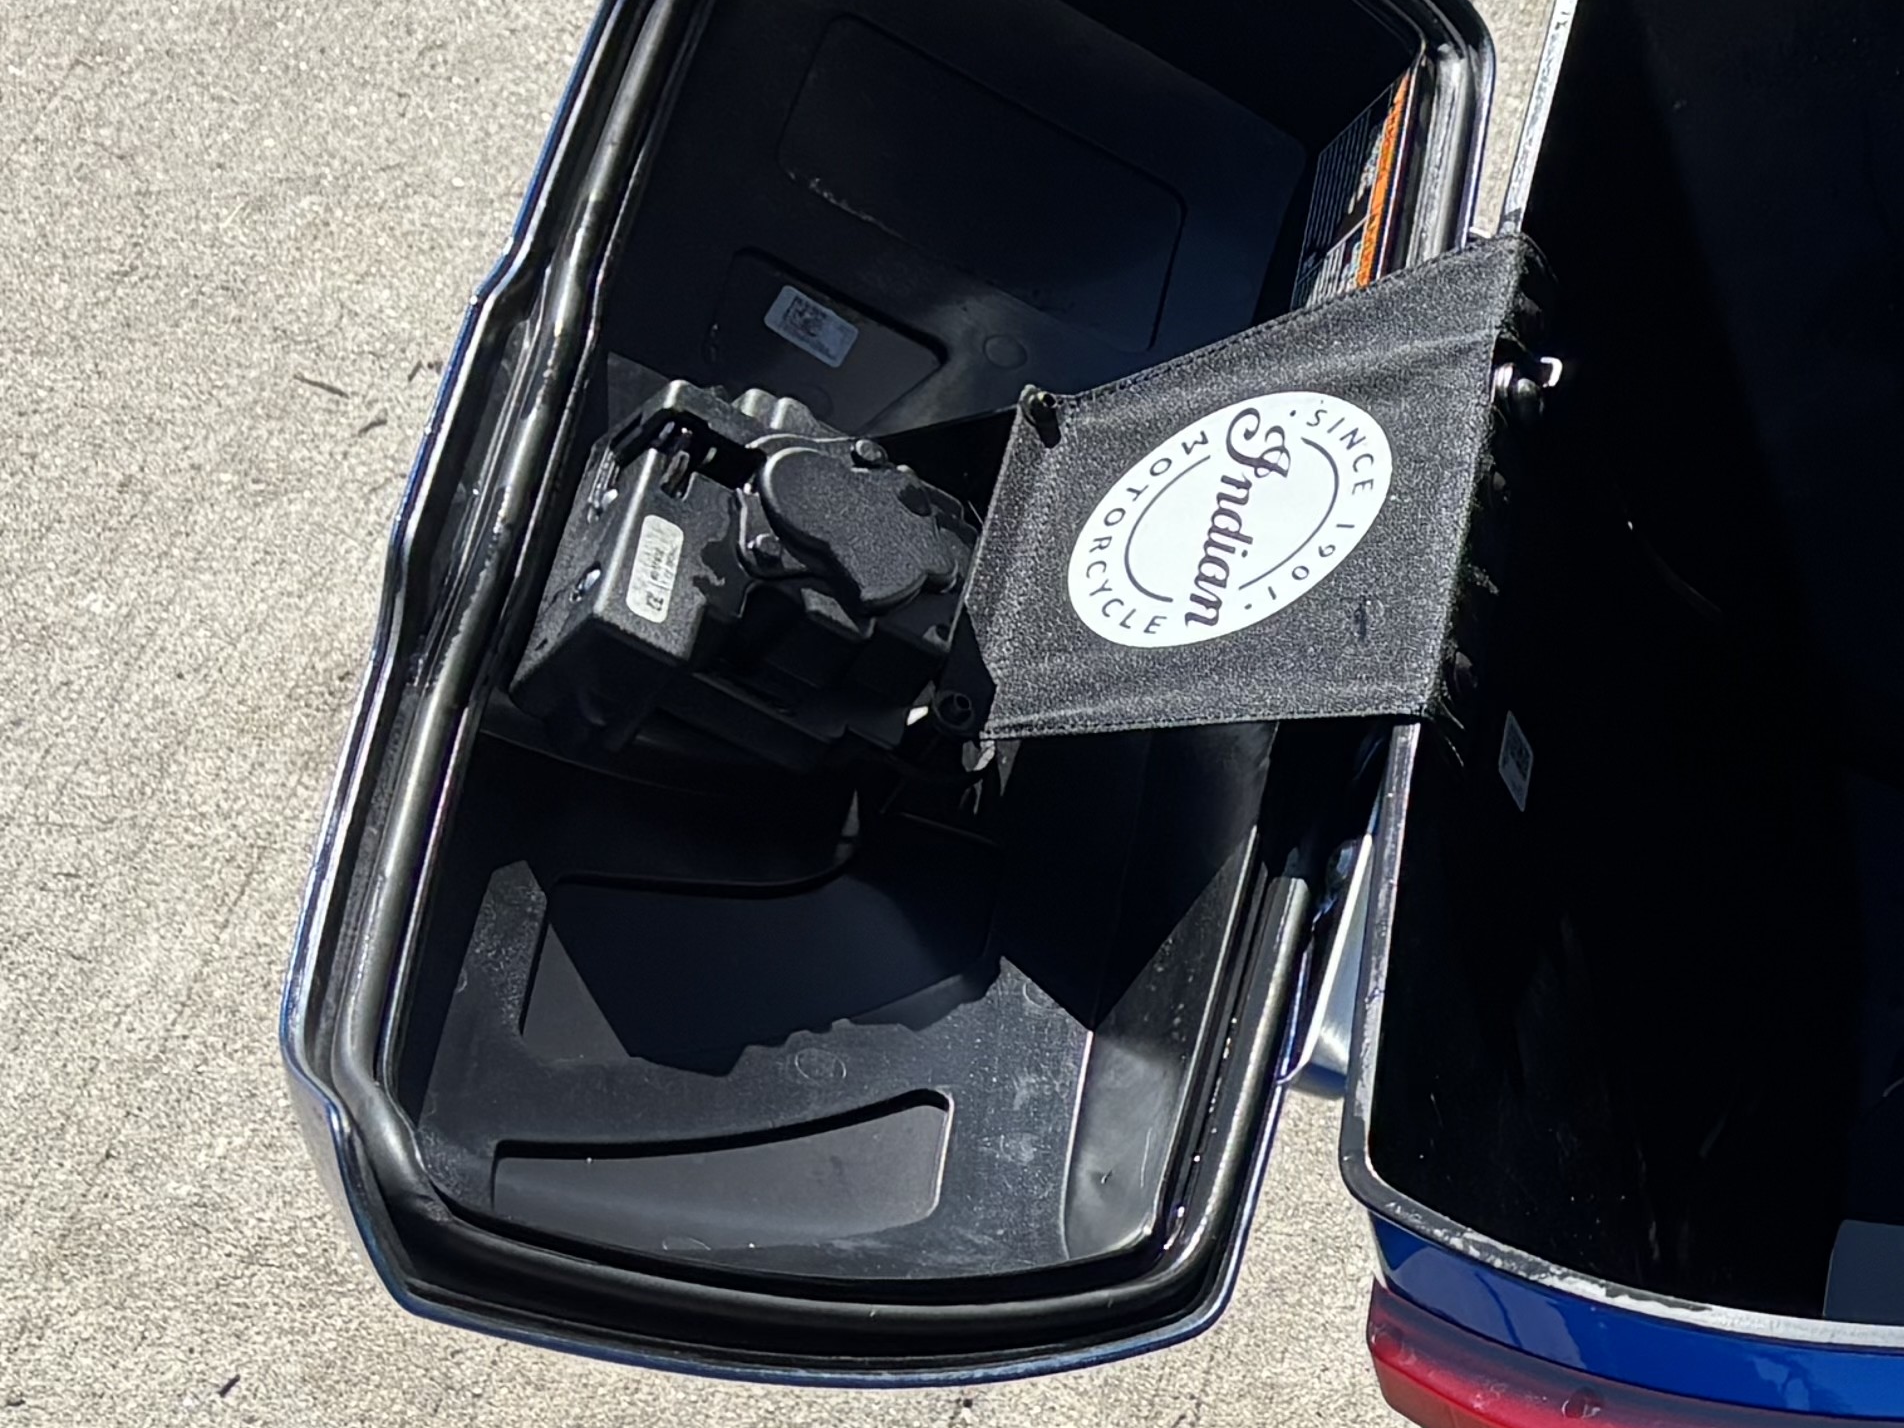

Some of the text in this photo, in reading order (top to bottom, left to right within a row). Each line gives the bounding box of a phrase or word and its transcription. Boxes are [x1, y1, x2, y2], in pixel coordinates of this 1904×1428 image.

[1184, 406, 1291, 627] Indian
[1306, 407, 1375, 496] SINCE
[1084, 429, 1210, 636] MOTORCYCLE
[1266, 522, 1356, 601] 1901
